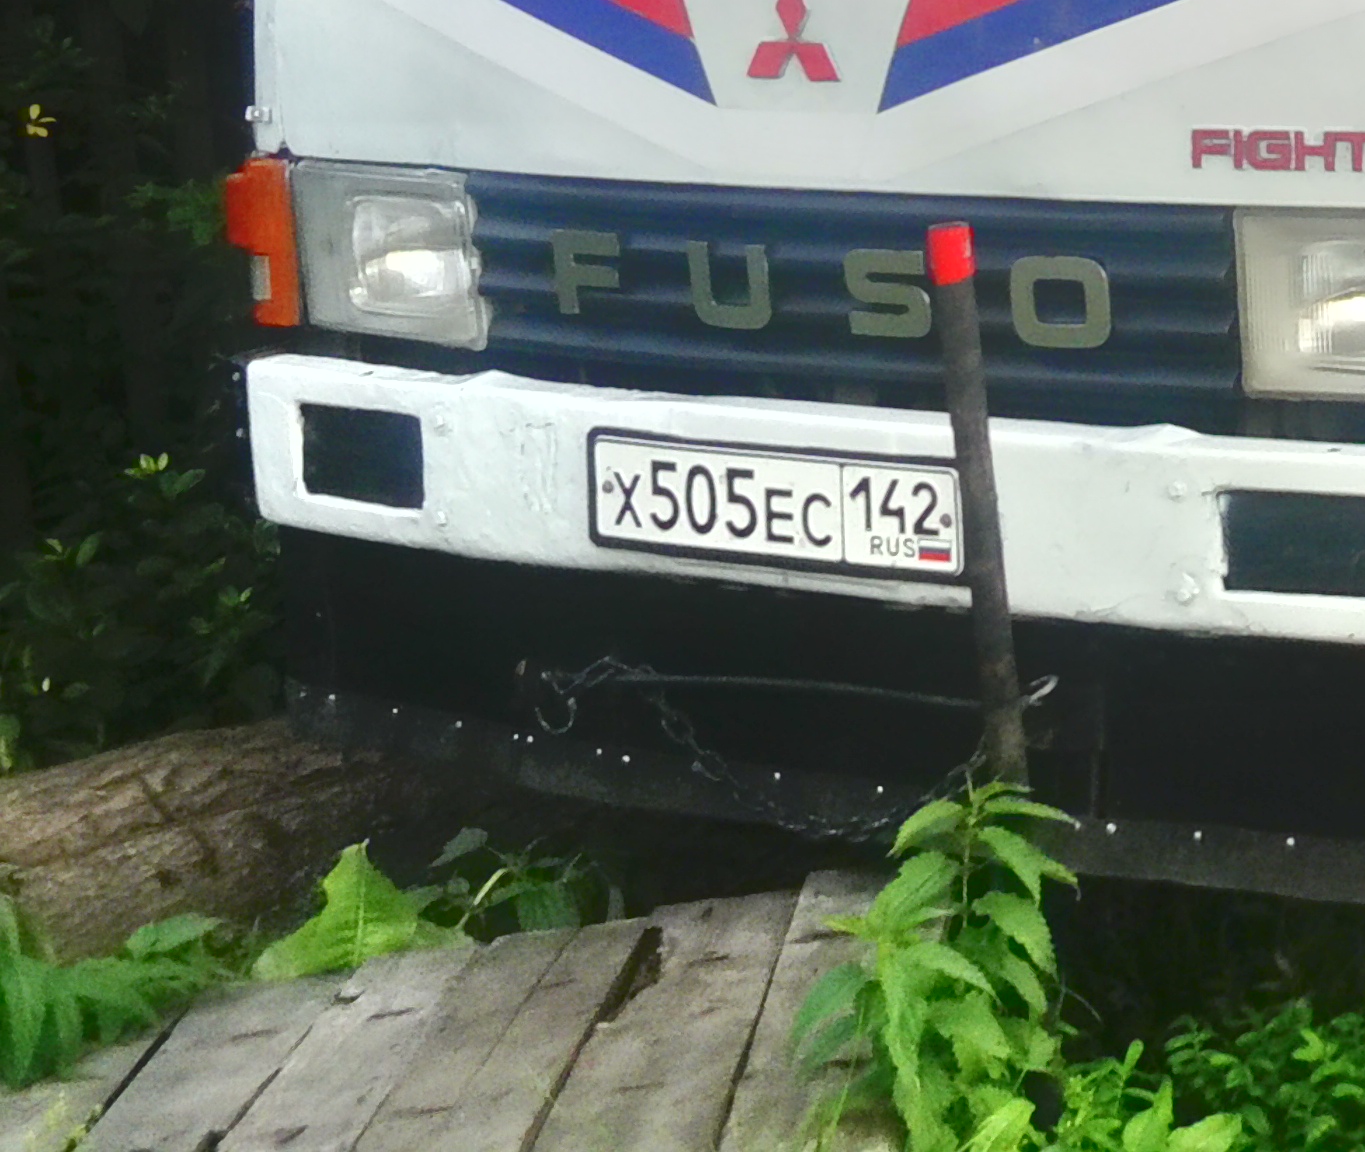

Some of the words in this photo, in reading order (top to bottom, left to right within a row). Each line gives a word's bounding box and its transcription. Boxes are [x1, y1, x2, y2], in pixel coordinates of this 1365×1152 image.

[551, 229, 1111, 347] FUSO
[849, 476, 939, 536] 142
[869, 536, 916, 558] RUS
